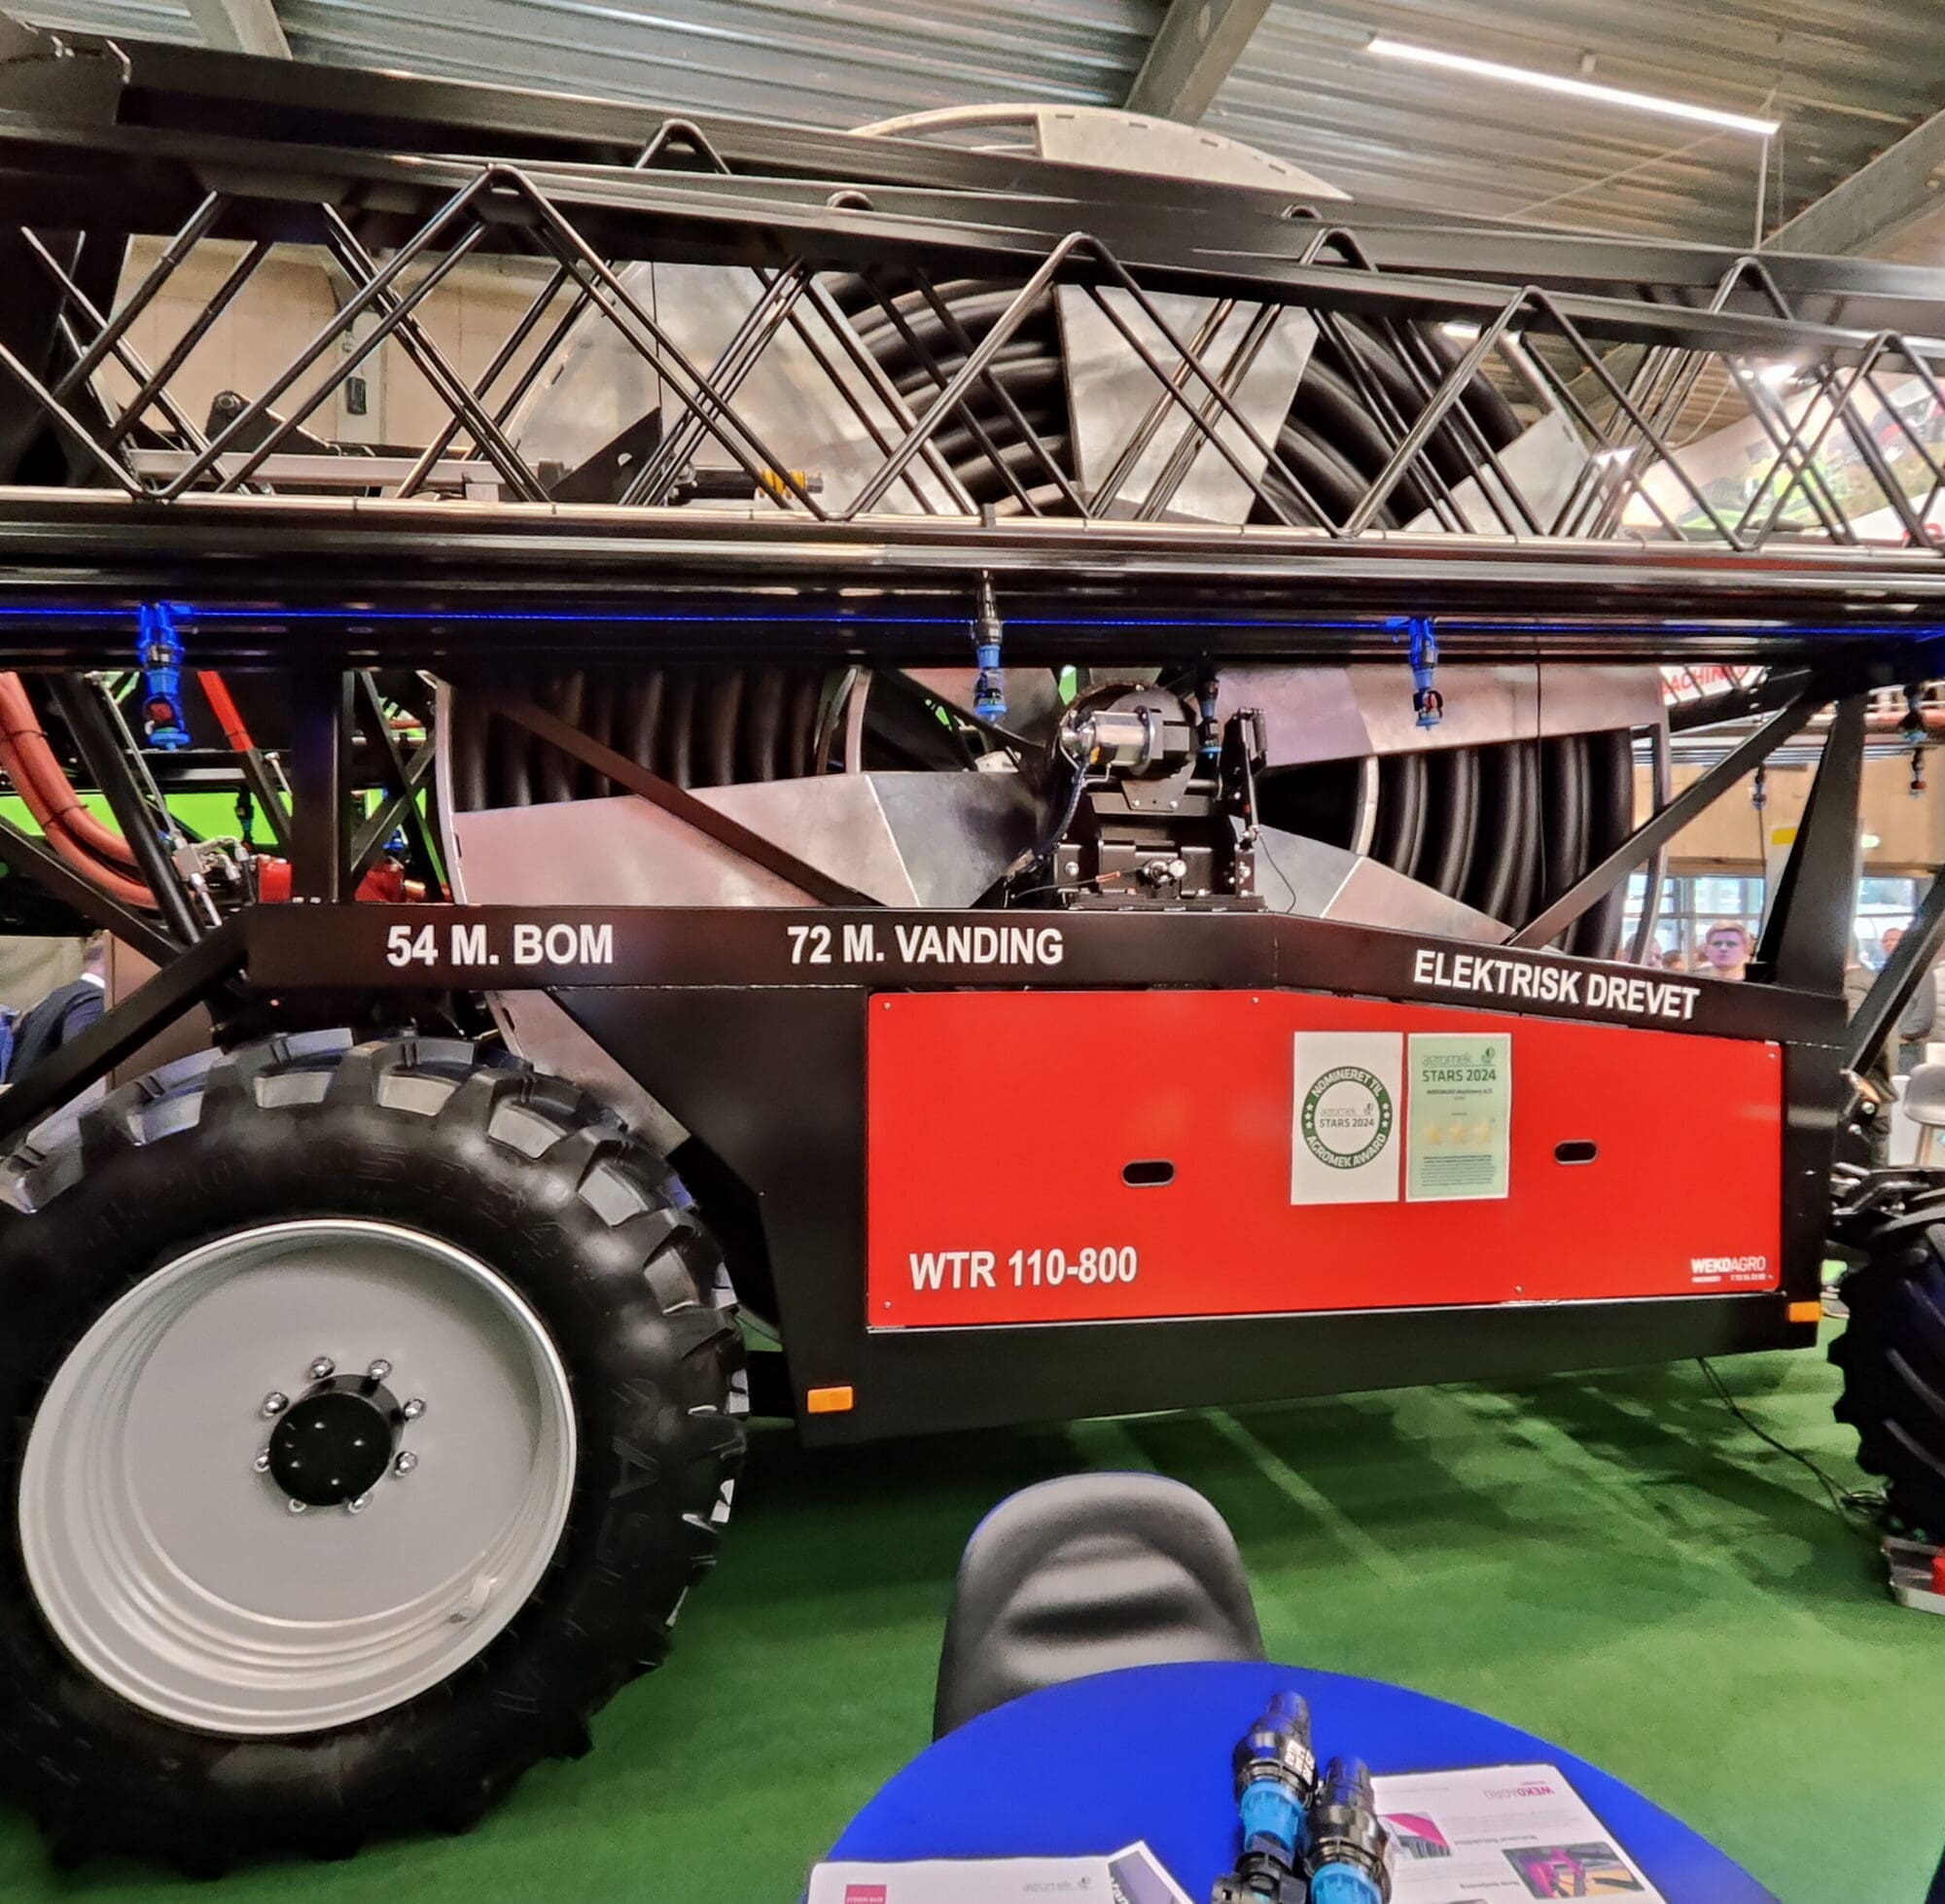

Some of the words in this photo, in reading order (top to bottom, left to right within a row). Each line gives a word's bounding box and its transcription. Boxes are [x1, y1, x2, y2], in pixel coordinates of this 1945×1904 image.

[387, 925, 438, 967] 54
[451, 924, 500, 965] M.
[513, 924, 614, 965] BOM
[788, 926, 831, 964] 72
[843, 925, 885, 963] M.
[895, 925, 1063, 965] VANDING
[1414, 949, 1582, 1005] ELEKTRISK
[1587, 973, 1701, 1020] DREVET
[1311, 1068, 1372, 1098] NOMINERET
[1368, 1078, 1383, 1097] TIL
[1422, 1070, 1464, 1082] STARS
[1466, 1069, 1497, 1081] 2024
[1320, 1118, 1350, 1128] STARS
[1352, 1117, 1374, 1127] 2024
[1306, 1135, 1352, 1168] AGROMEK
[1353, 1133, 1387, 1166] AWARD
[909, 1251, 996, 1290] WTR
[1008, 1246, 1137, 1287] 110-800
[1690, 1255, 1766, 1274] WEKOAGRO
